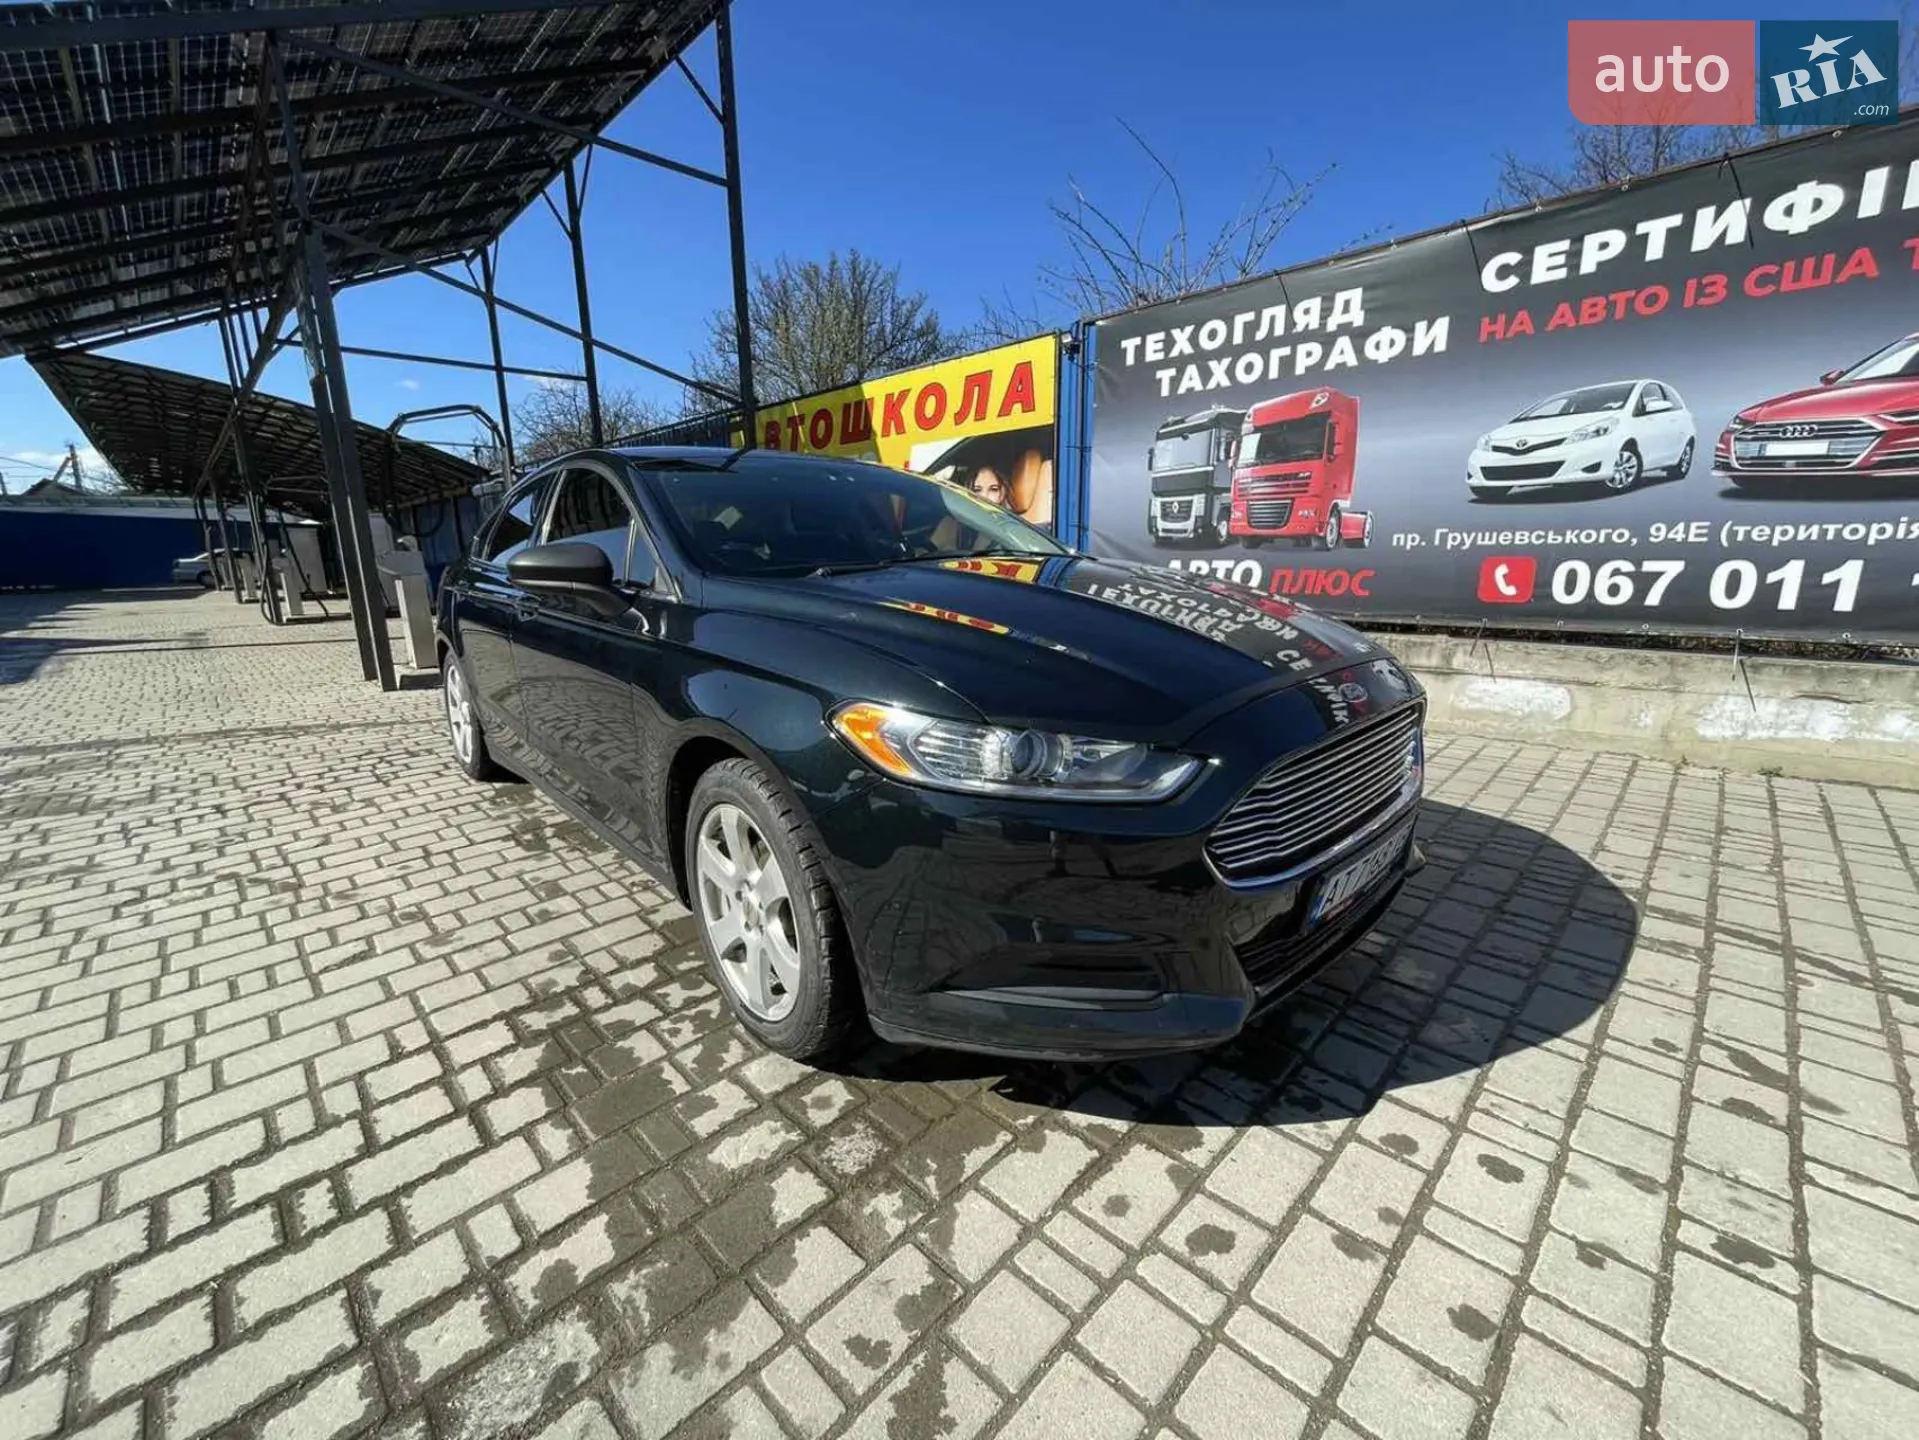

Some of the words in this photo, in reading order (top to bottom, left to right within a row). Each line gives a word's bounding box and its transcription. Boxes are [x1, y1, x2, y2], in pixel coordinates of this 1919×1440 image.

[1120, 286, 1365, 367] ТЕХОГЛЯД
[1478, 309, 1535, 343] НА
[1546, 285, 1669, 331] АВТО
[1683, 274, 1729, 309] ІЗ
[1743, 247, 1880, 297] США
[1155, 315, 1450, 398] ТАХОГРАФИ
[765, 361, 1036, 452] ВТОШКОЛА
[1391, 531, 1427, 550] пр.
[1433, 527, 1638, 550] Грушевського,
[1649, 520, 1711, 543] 94Е
[1269, 567, 1376, 597] ПЛЮС
[1551, 558, 1686, 607] 067
[1709, 558, 1865, 613] 011
